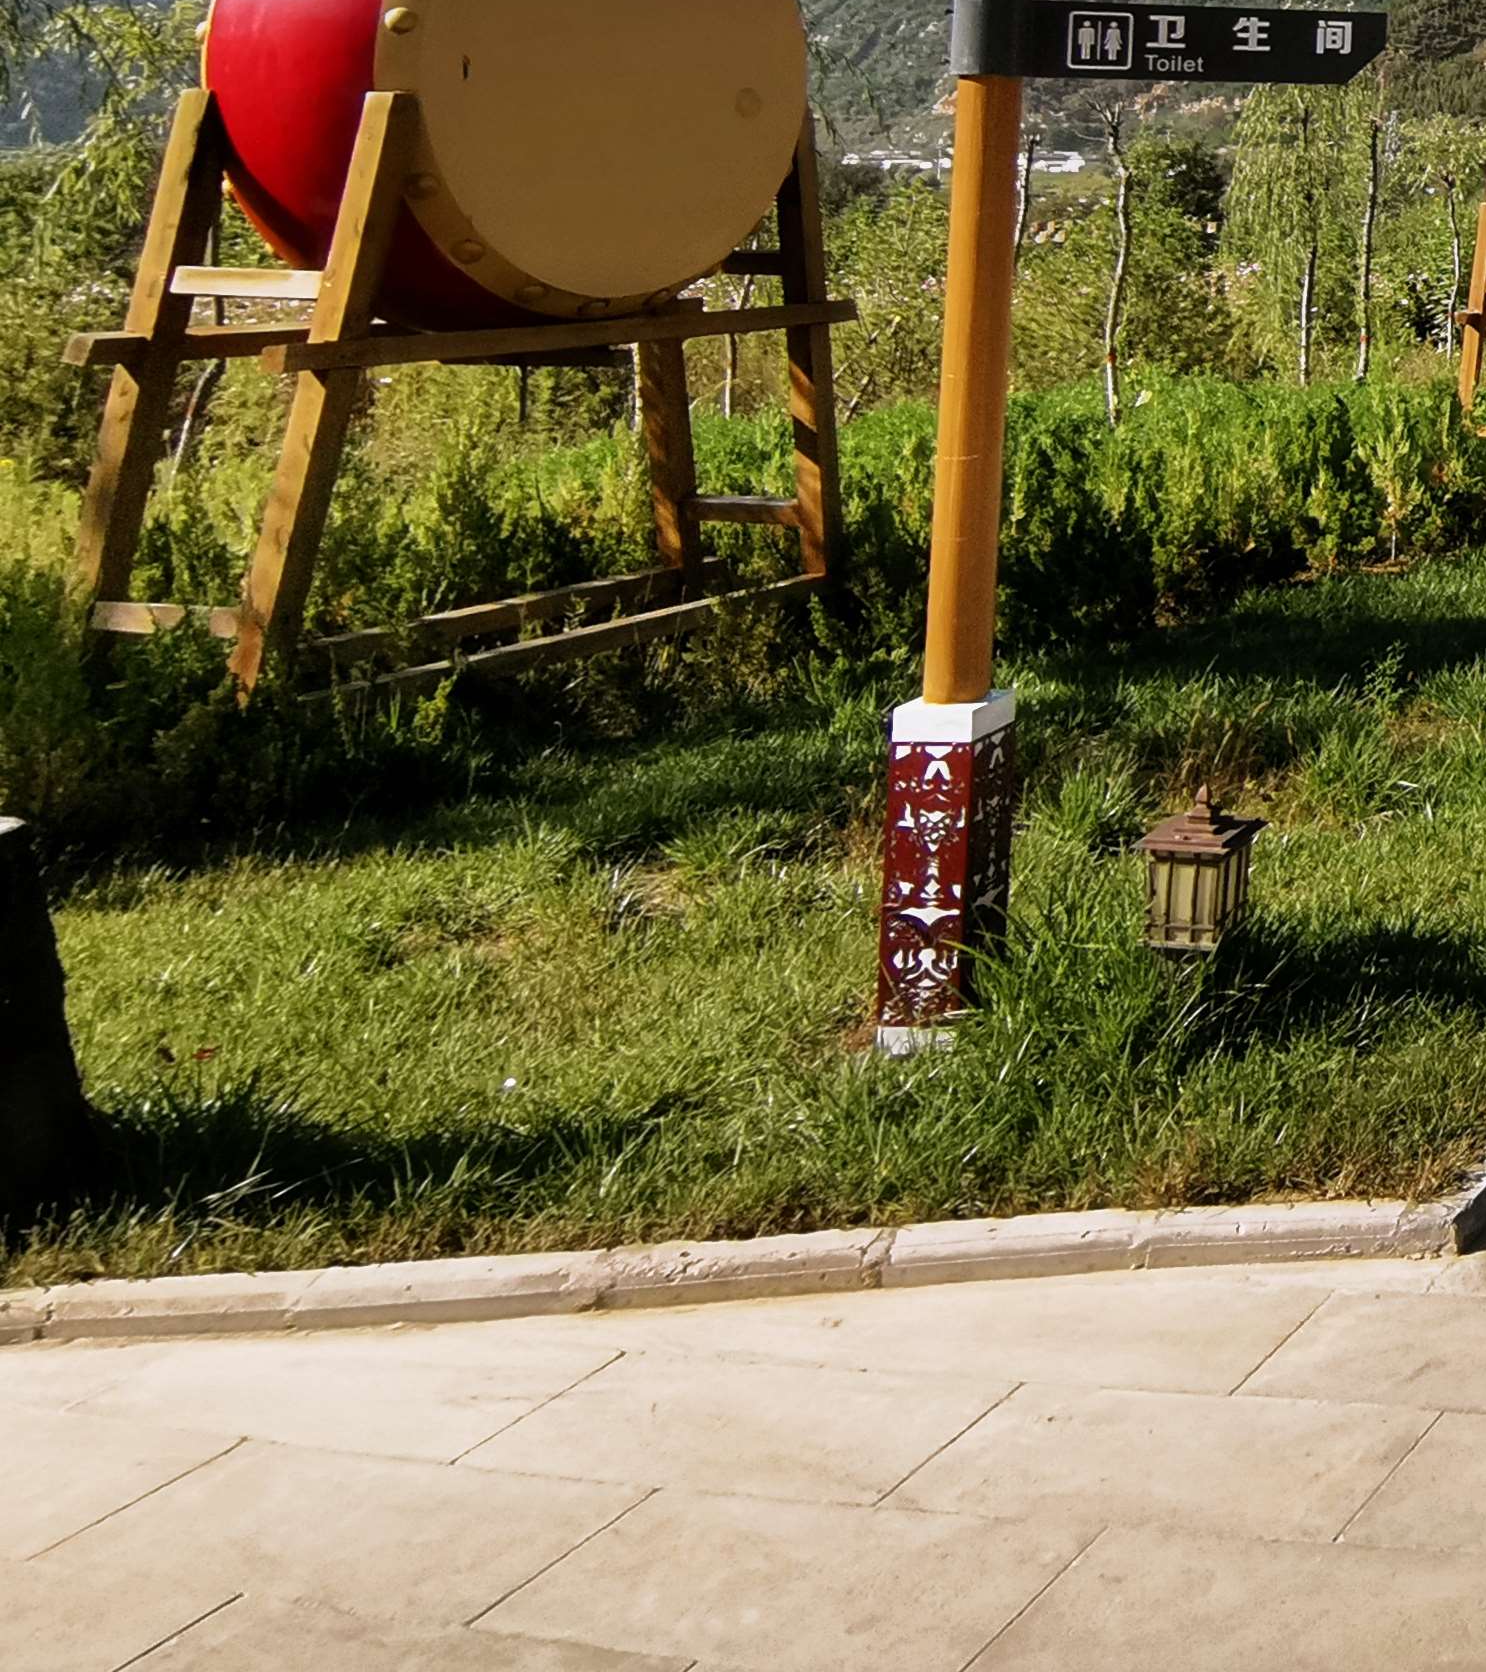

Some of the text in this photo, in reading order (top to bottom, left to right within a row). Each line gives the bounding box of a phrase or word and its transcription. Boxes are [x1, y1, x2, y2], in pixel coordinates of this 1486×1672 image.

[1146, 15, 1352, 54] 卫生间
[1145, 54, 1204, 72] Toilet
